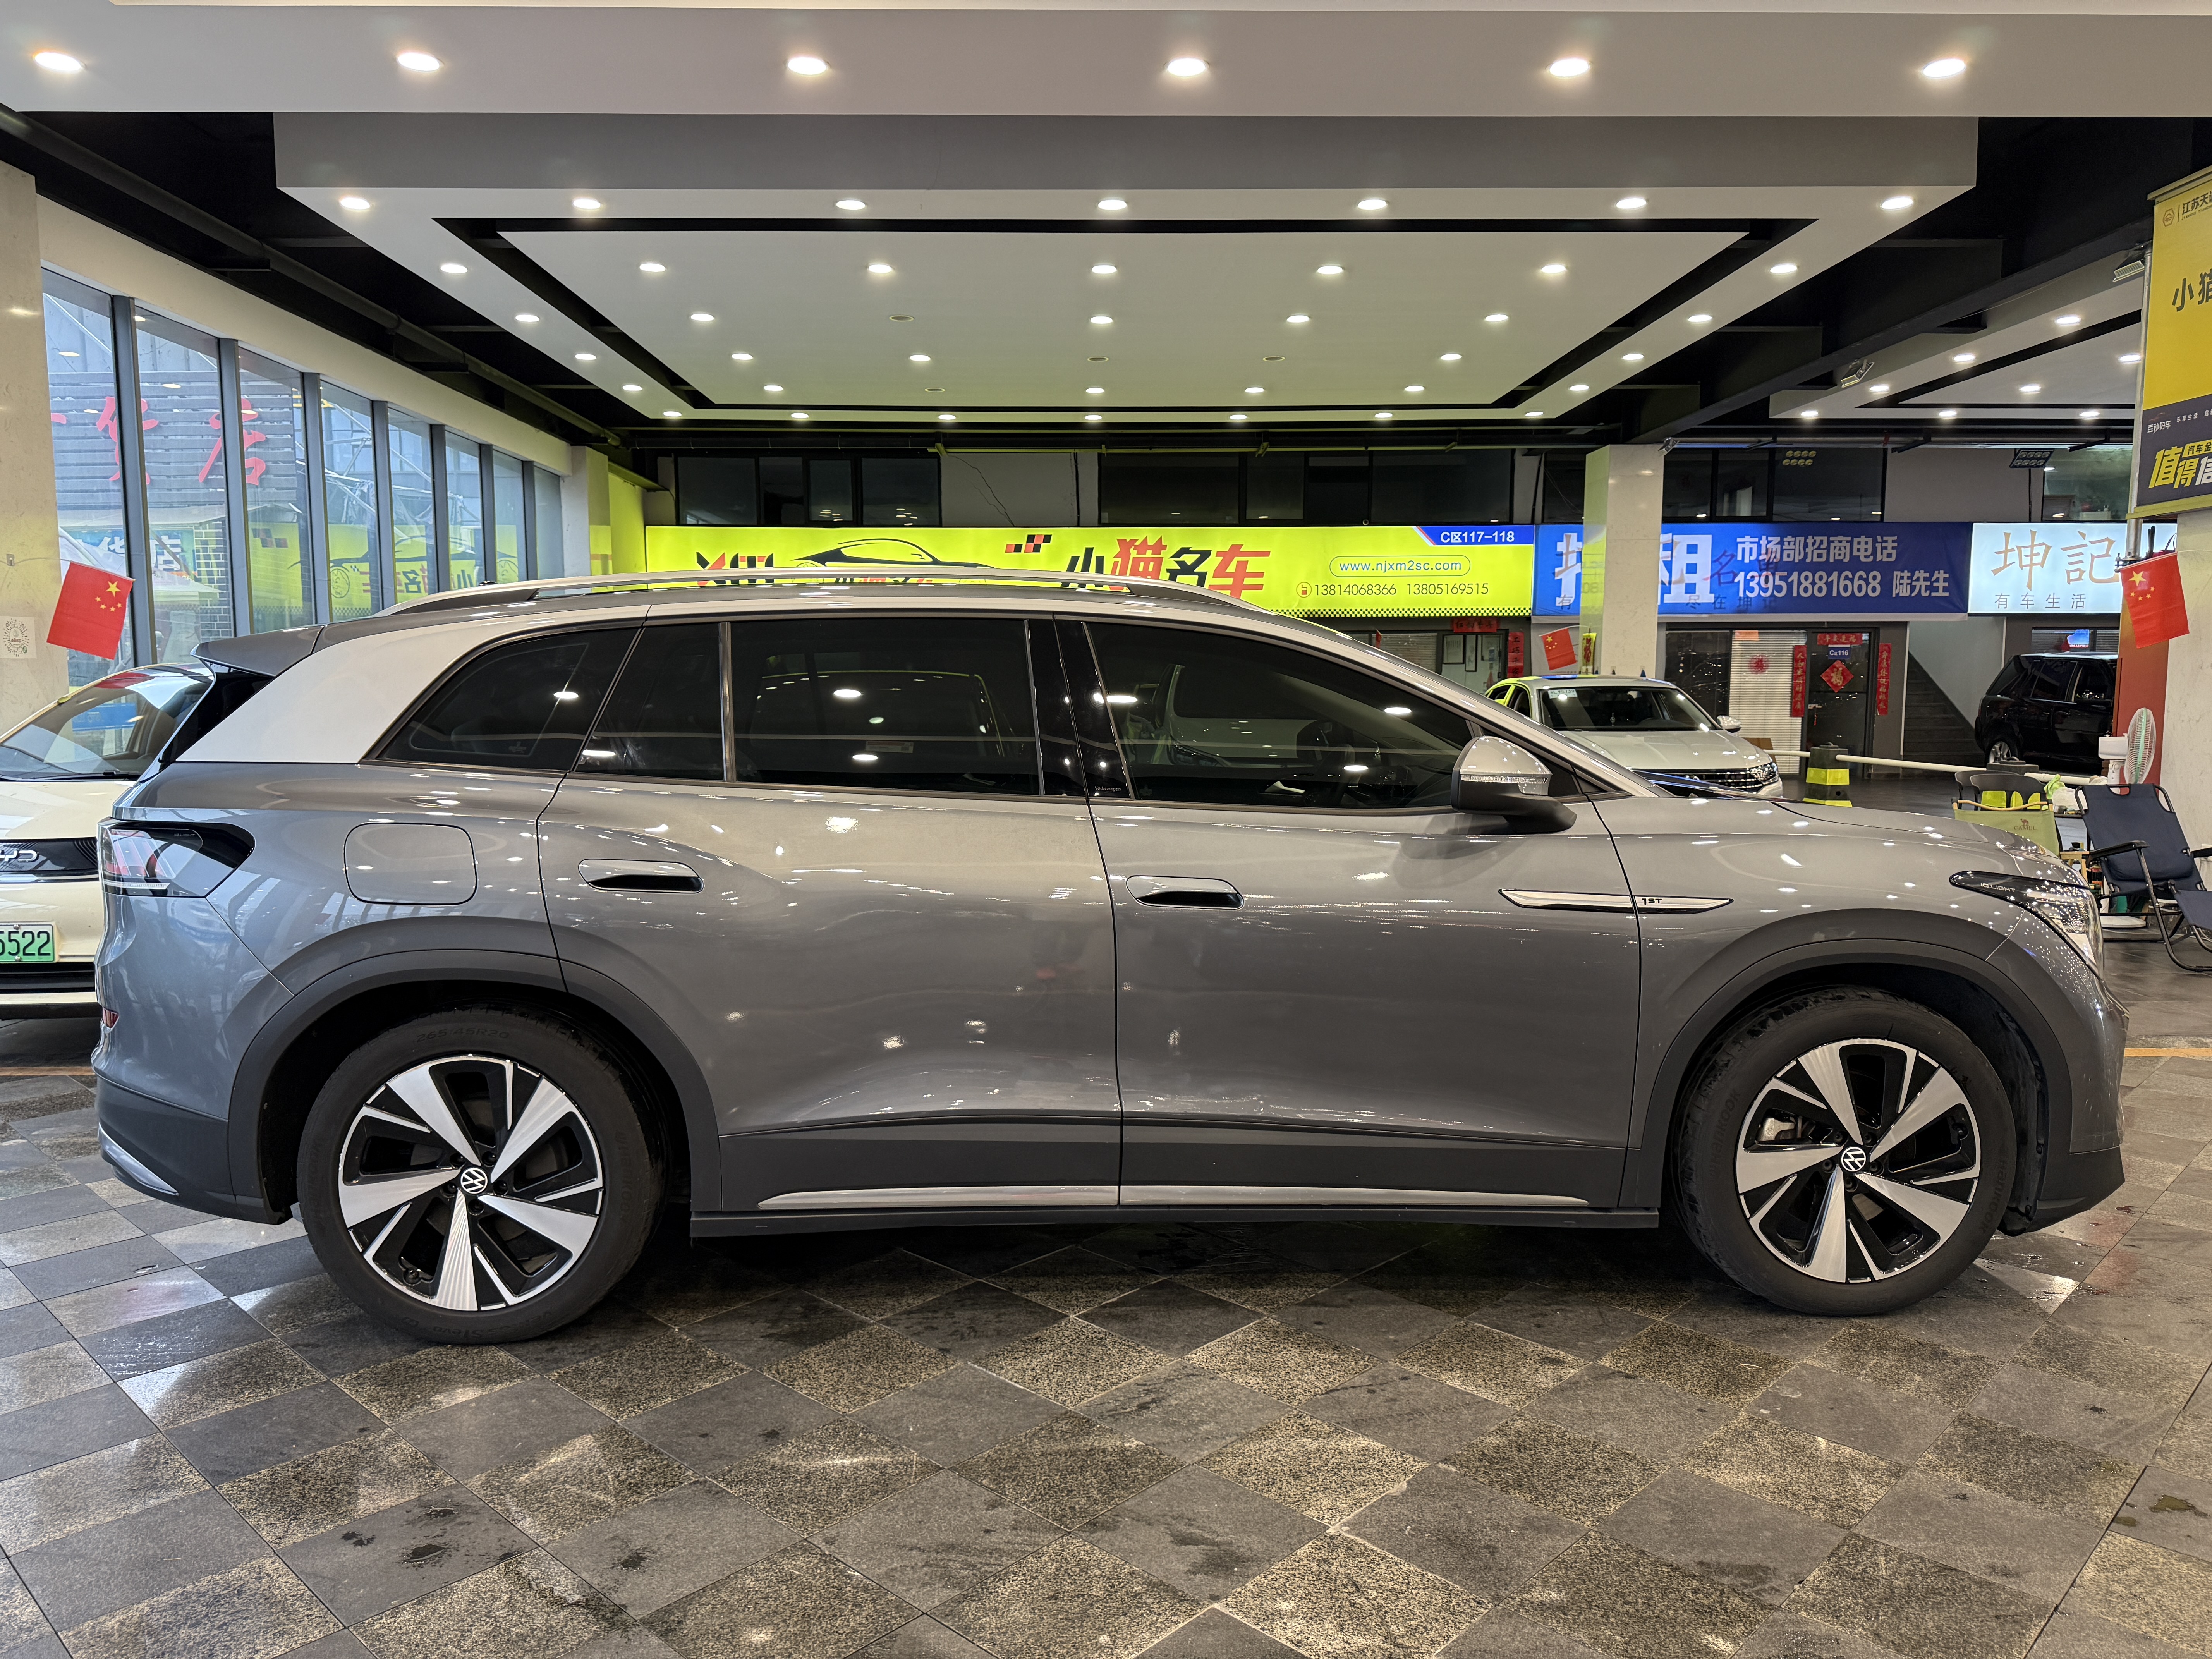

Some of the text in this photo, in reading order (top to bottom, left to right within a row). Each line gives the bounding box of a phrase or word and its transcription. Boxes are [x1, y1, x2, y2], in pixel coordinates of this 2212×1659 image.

[1441, 531, 1515, 543] C区117-118
[1736, 535, 1898, 563] 市场部招商电话
[1061, 535, 1270, 599] 小猫名车
[1339, 560, 1462, 573] www.njxm2sc.com
[1314, 583, 1489, 596] 13814068366 13805169515
[1735, 570, 1949, 597] 13951881668 陆先生
[1995, 593, 2086, 609] 有车生活
[1980, 883, 2016, 892] IQ.LIGHT
